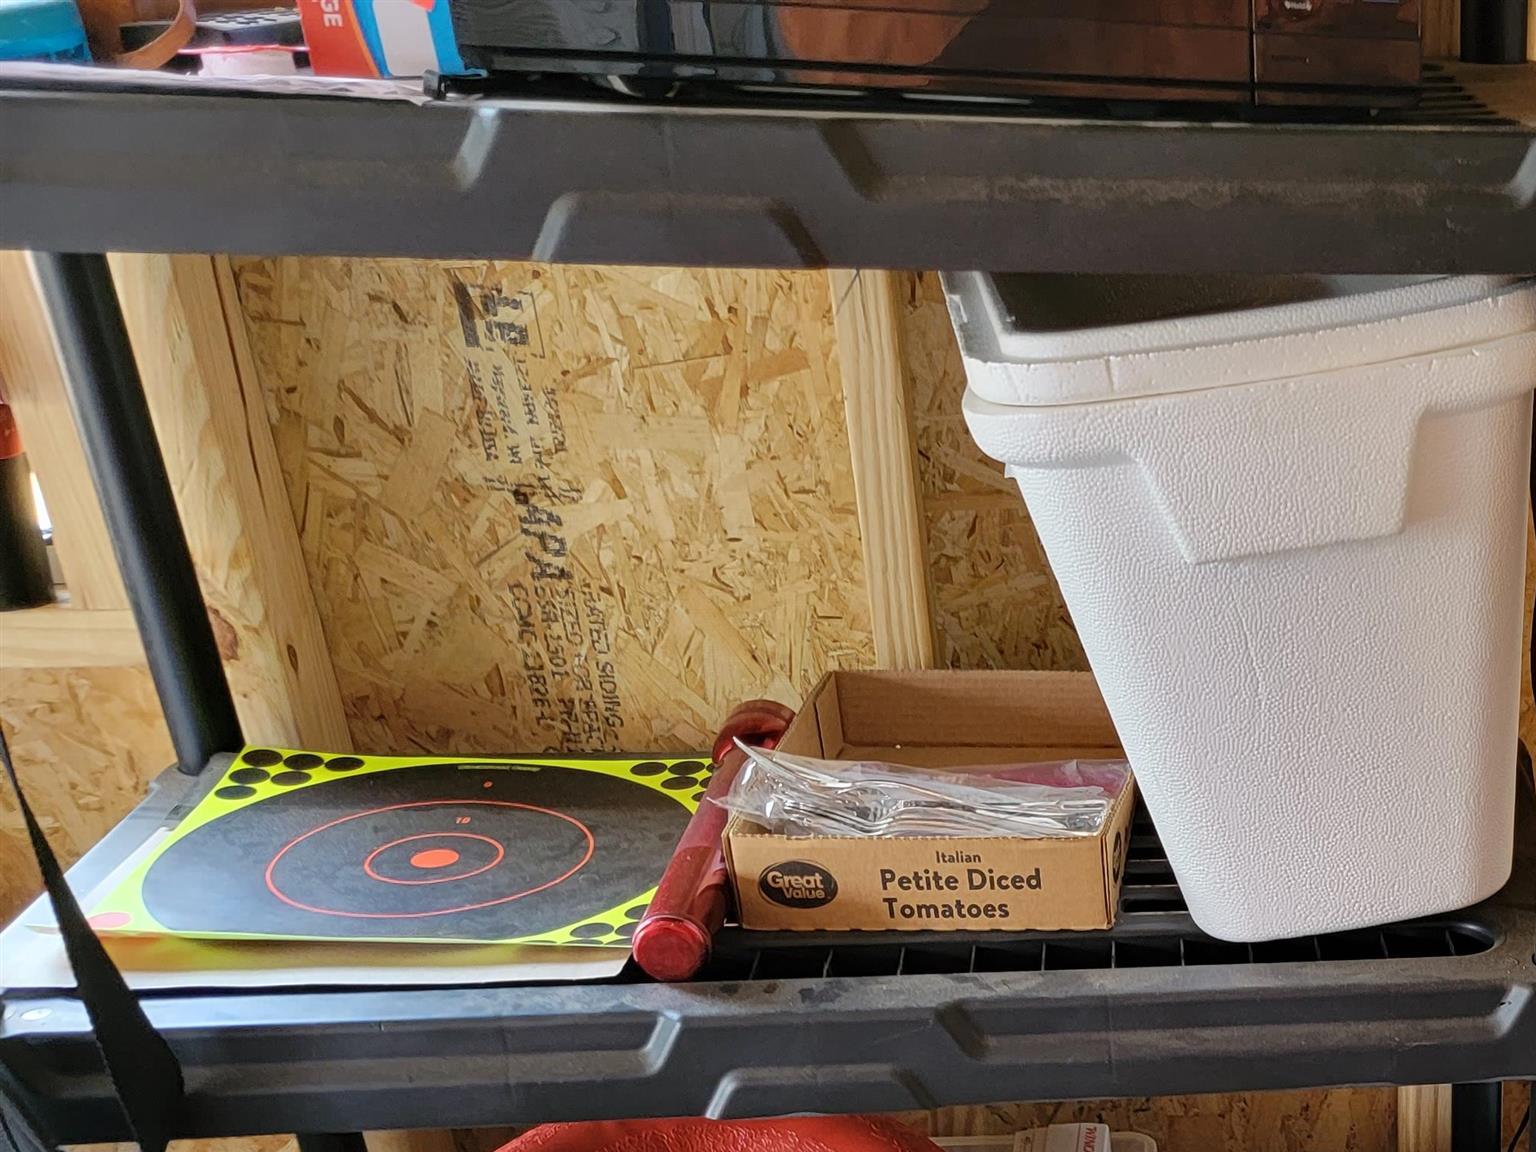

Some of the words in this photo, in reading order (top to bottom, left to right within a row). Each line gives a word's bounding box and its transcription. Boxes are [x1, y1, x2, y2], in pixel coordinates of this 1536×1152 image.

[935, 851, 982, 864] Italian
[765, 869, 825, 891] Great
[879, 868, 960, 891] Petite
[967, 867, 1043, 891] Diced
[782, 884, 828, 900] Value
[883, 897, 1010, 920] Tomatoes
